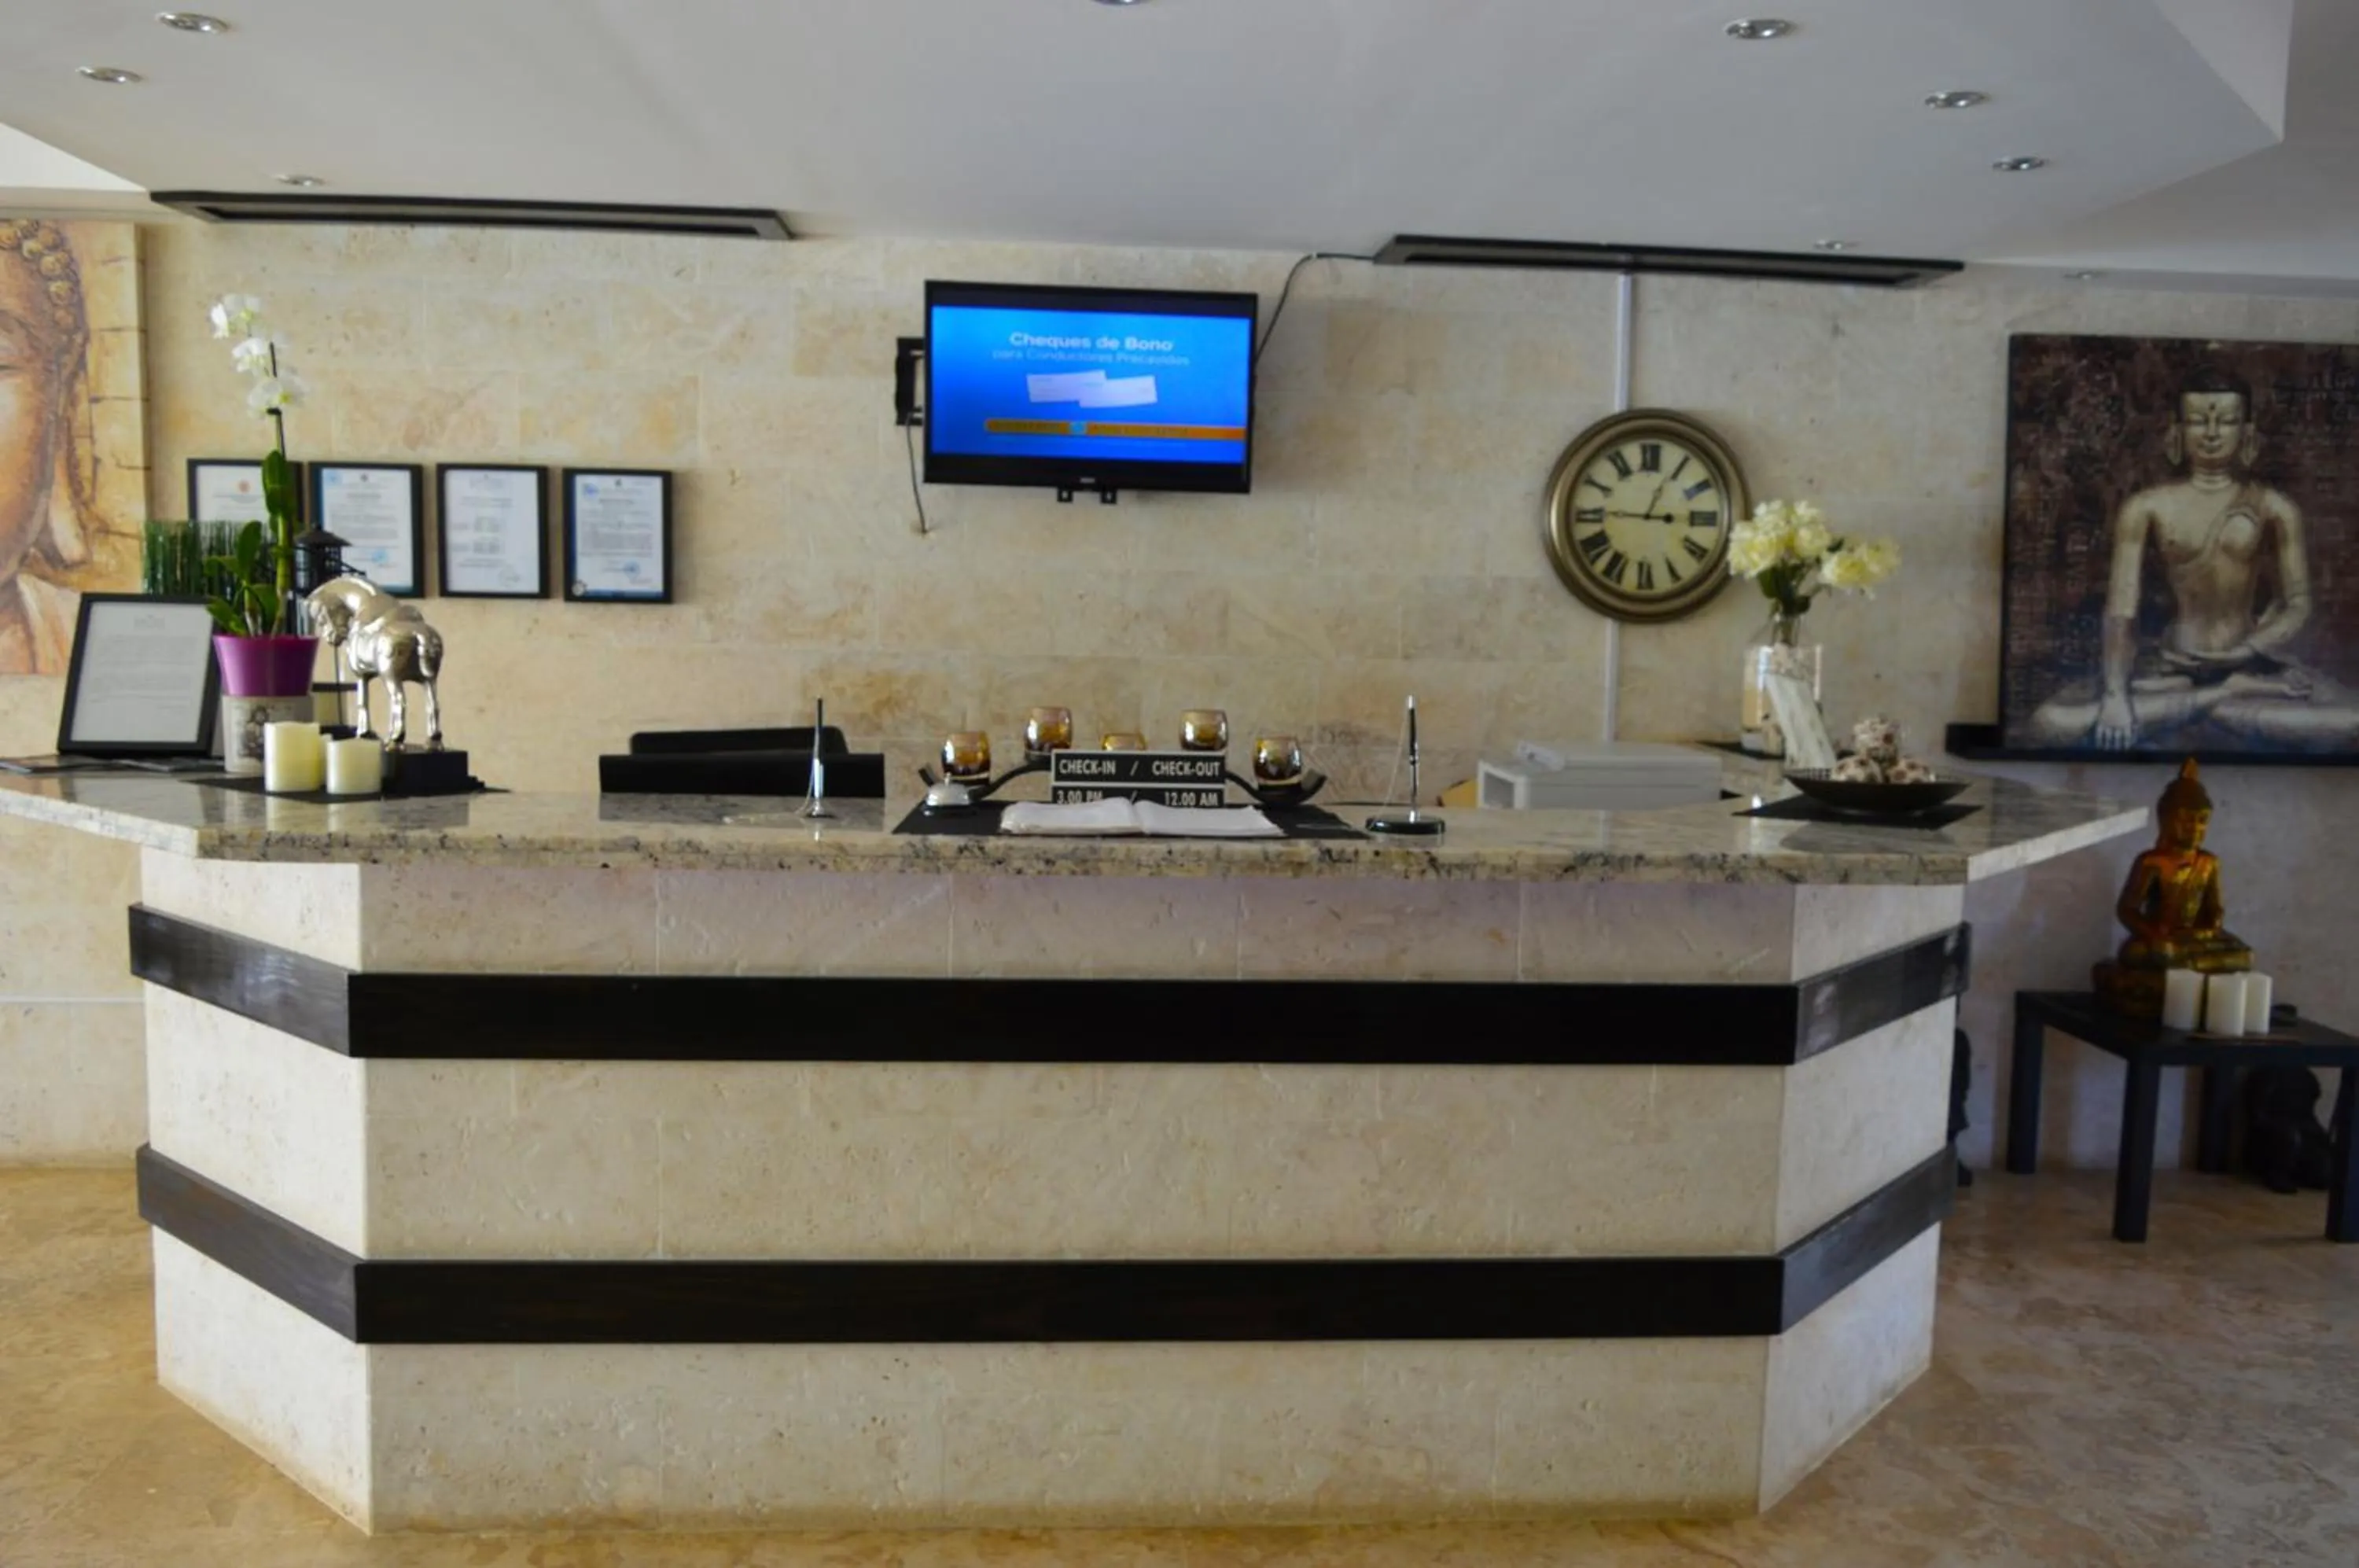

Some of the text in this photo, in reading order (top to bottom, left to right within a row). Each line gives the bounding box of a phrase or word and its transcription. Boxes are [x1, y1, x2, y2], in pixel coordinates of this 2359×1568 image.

[1010, 332, 1173, 352] Cheques de Bono
[1058, 759, 1221, 777] CHECK-IN / CHECK-OUT
[1057, 790, 1082, 804] 3.00
[1086, 790, 1102, 803] PM
[1165, 792, 1196, 807] 12.00
[1199, 793, 1219, 807] AM
